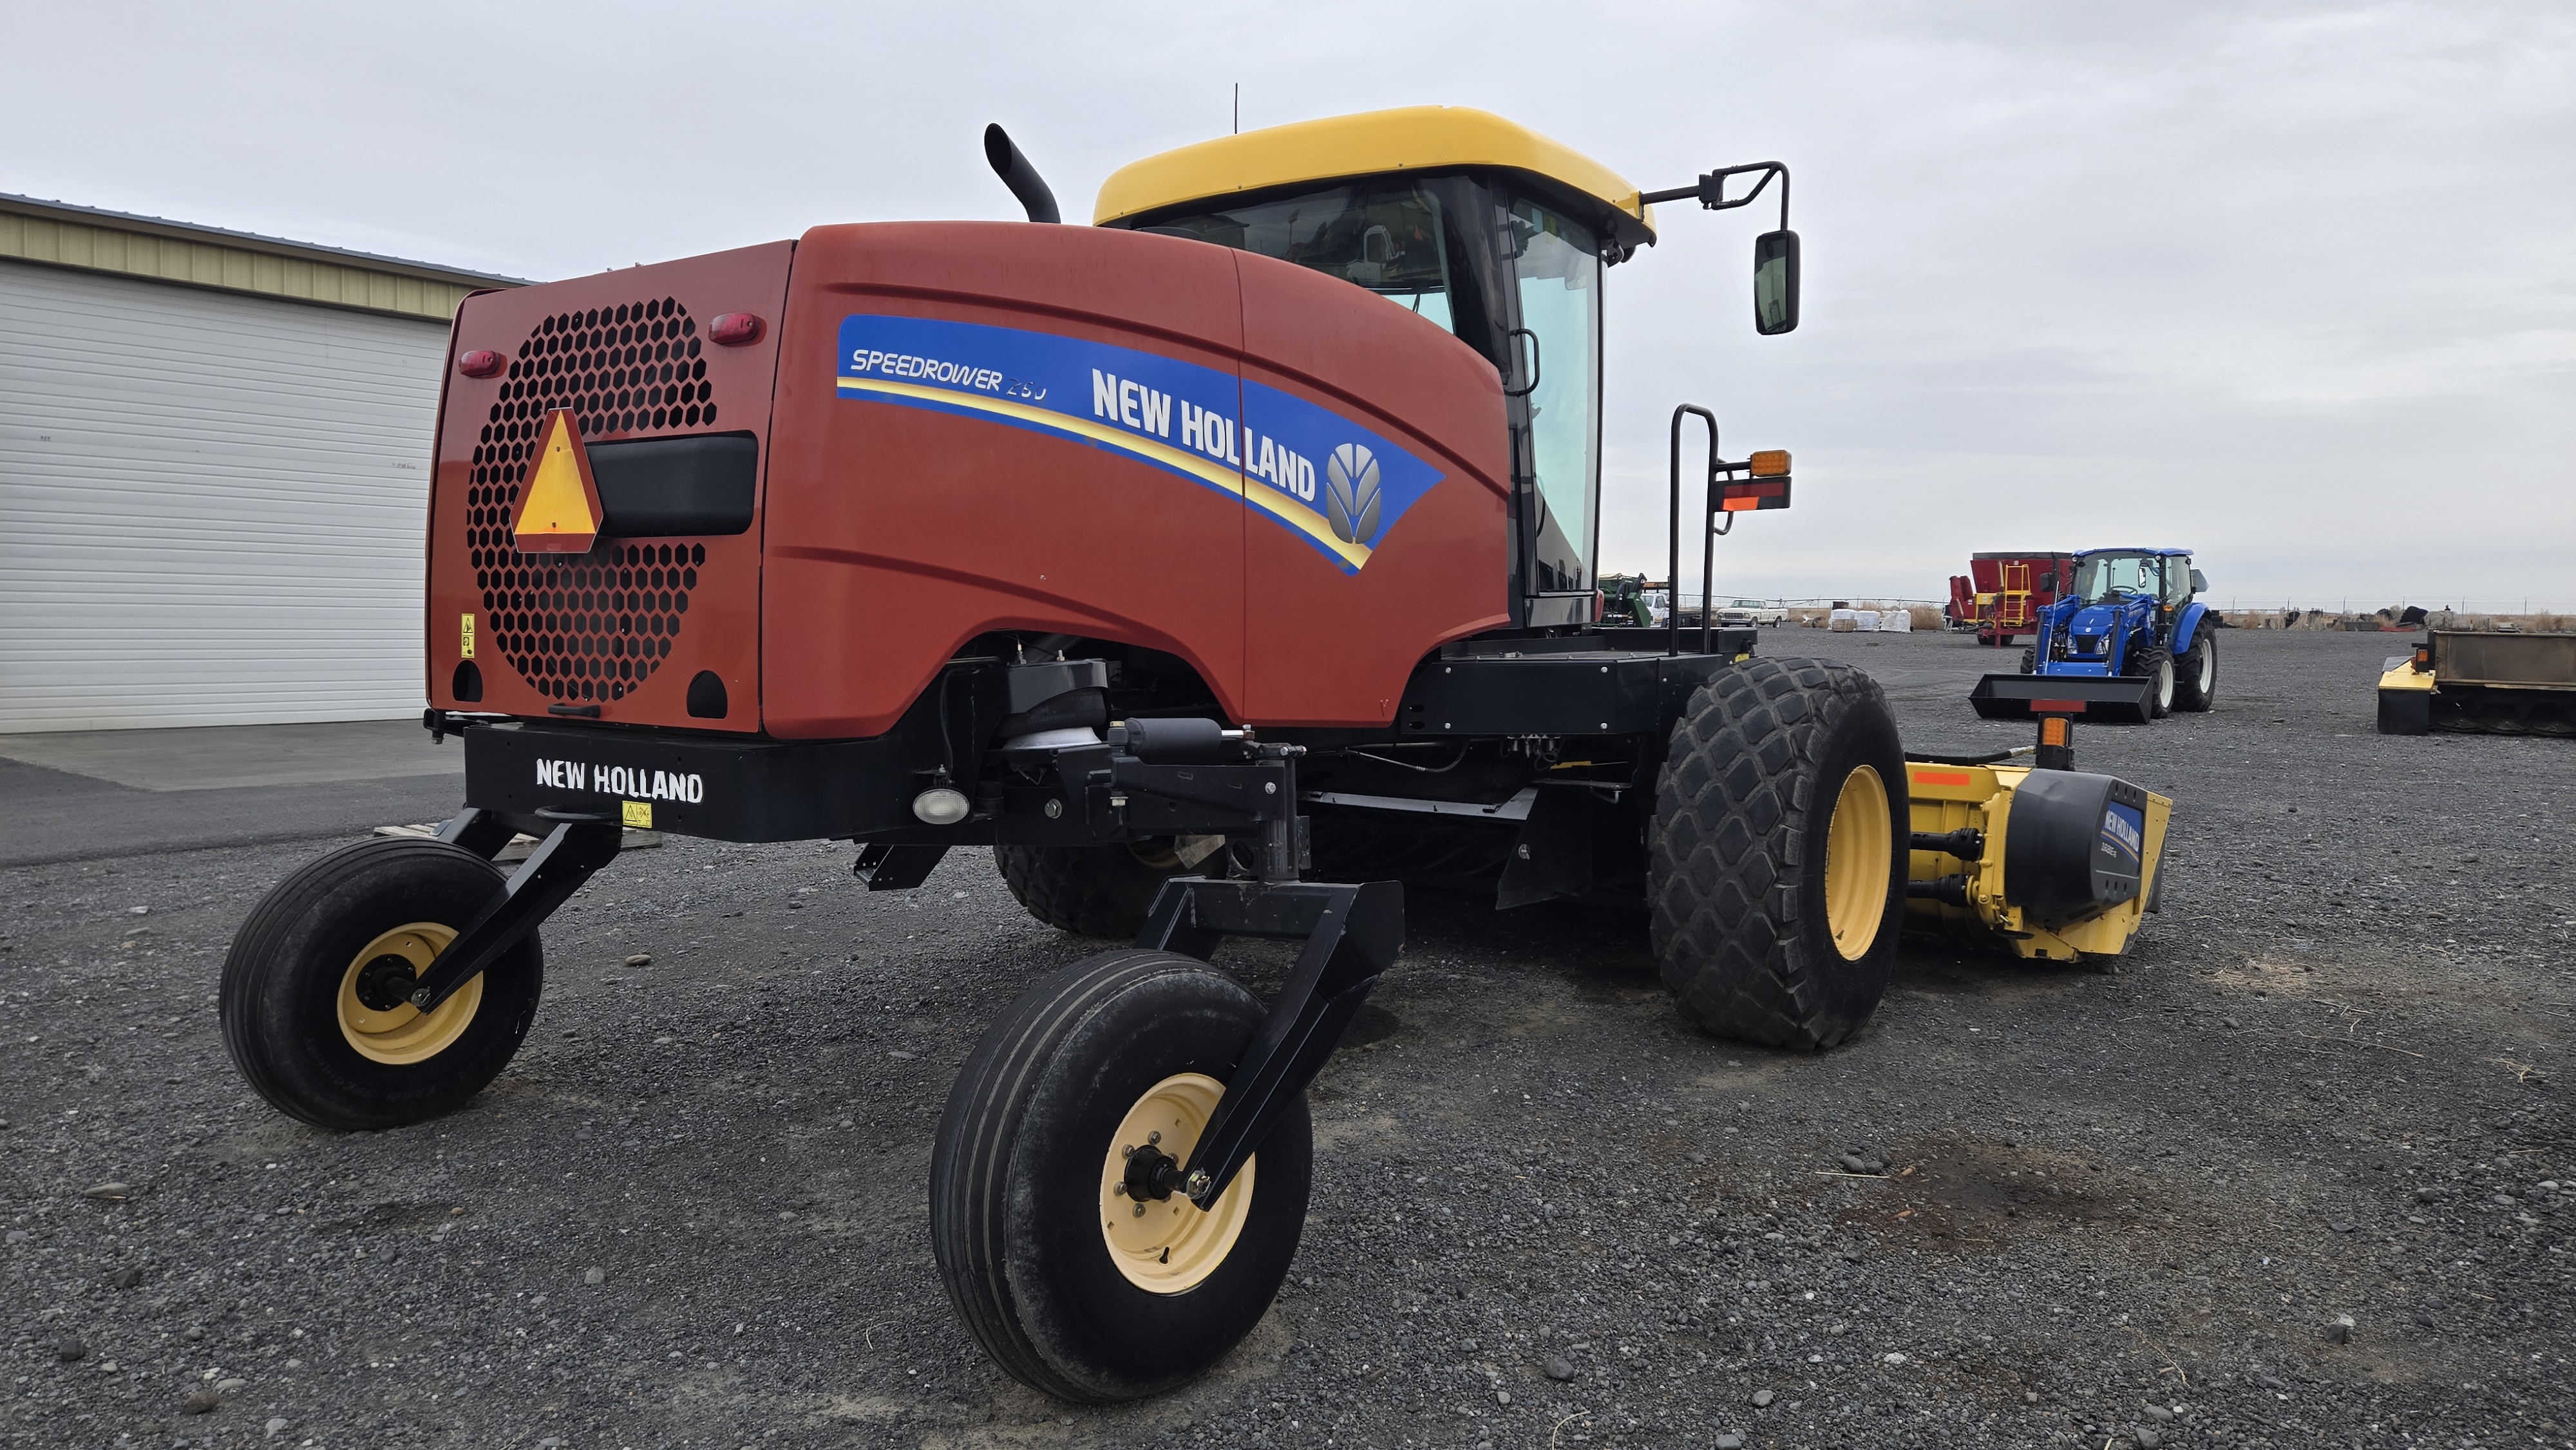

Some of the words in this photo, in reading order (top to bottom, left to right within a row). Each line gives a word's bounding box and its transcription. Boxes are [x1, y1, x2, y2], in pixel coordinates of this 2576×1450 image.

[850, 348, 1003, 392] SPEEDROWER
[1092, 368, 1172, 438] NEW
[1180, 405, 1316, 503] HOLLAND
[536, 758, 585, 790] NEW
[594, 764, 703, 804] HOLLAND
[2105, 810, 2117, 833] NEW
[2116, 816, 2139, 852] HOLLAND
